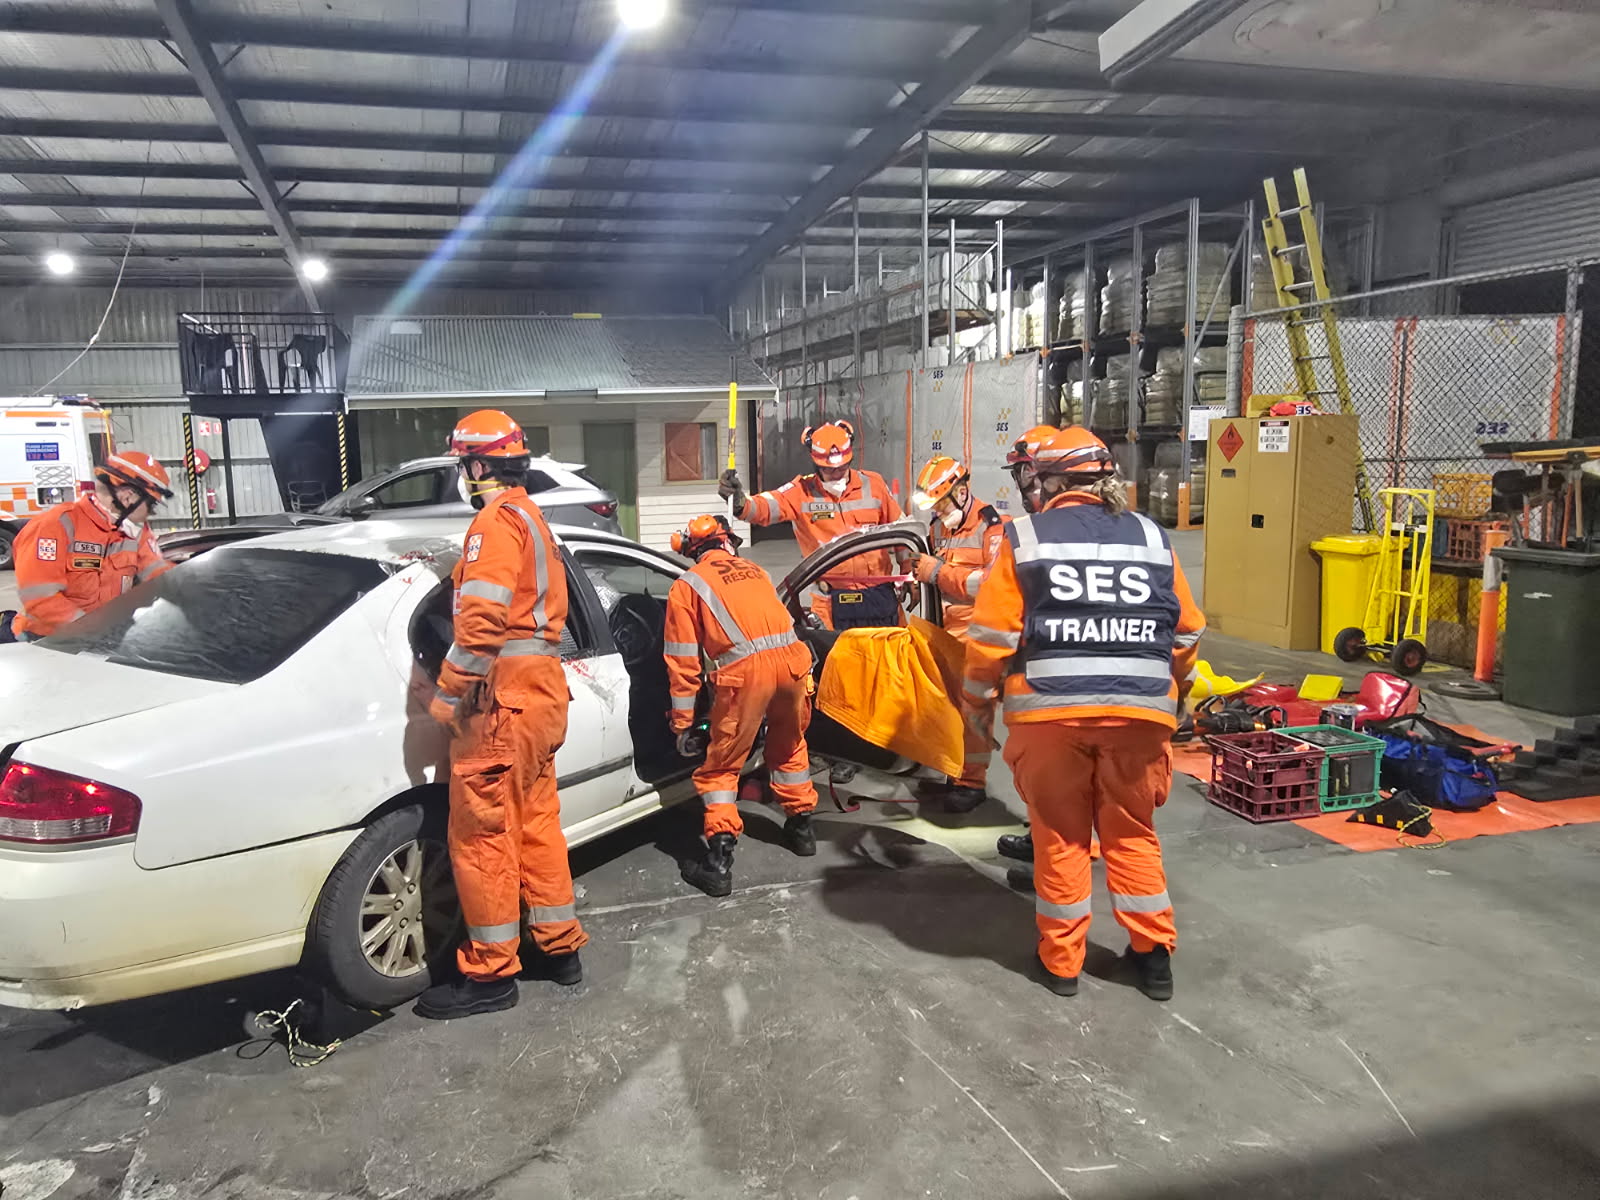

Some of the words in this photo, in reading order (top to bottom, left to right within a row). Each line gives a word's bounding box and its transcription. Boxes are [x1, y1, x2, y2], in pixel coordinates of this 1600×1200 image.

[933, 370, 943, 379] SES
[996, 422, 1008, 431] SES
[932, 442, 941, 450] SES
[81, 544, 95, 552] SES
[1049, 564, 1152, 604] SES
[1044, 617, 1157, 642] TRAINER
